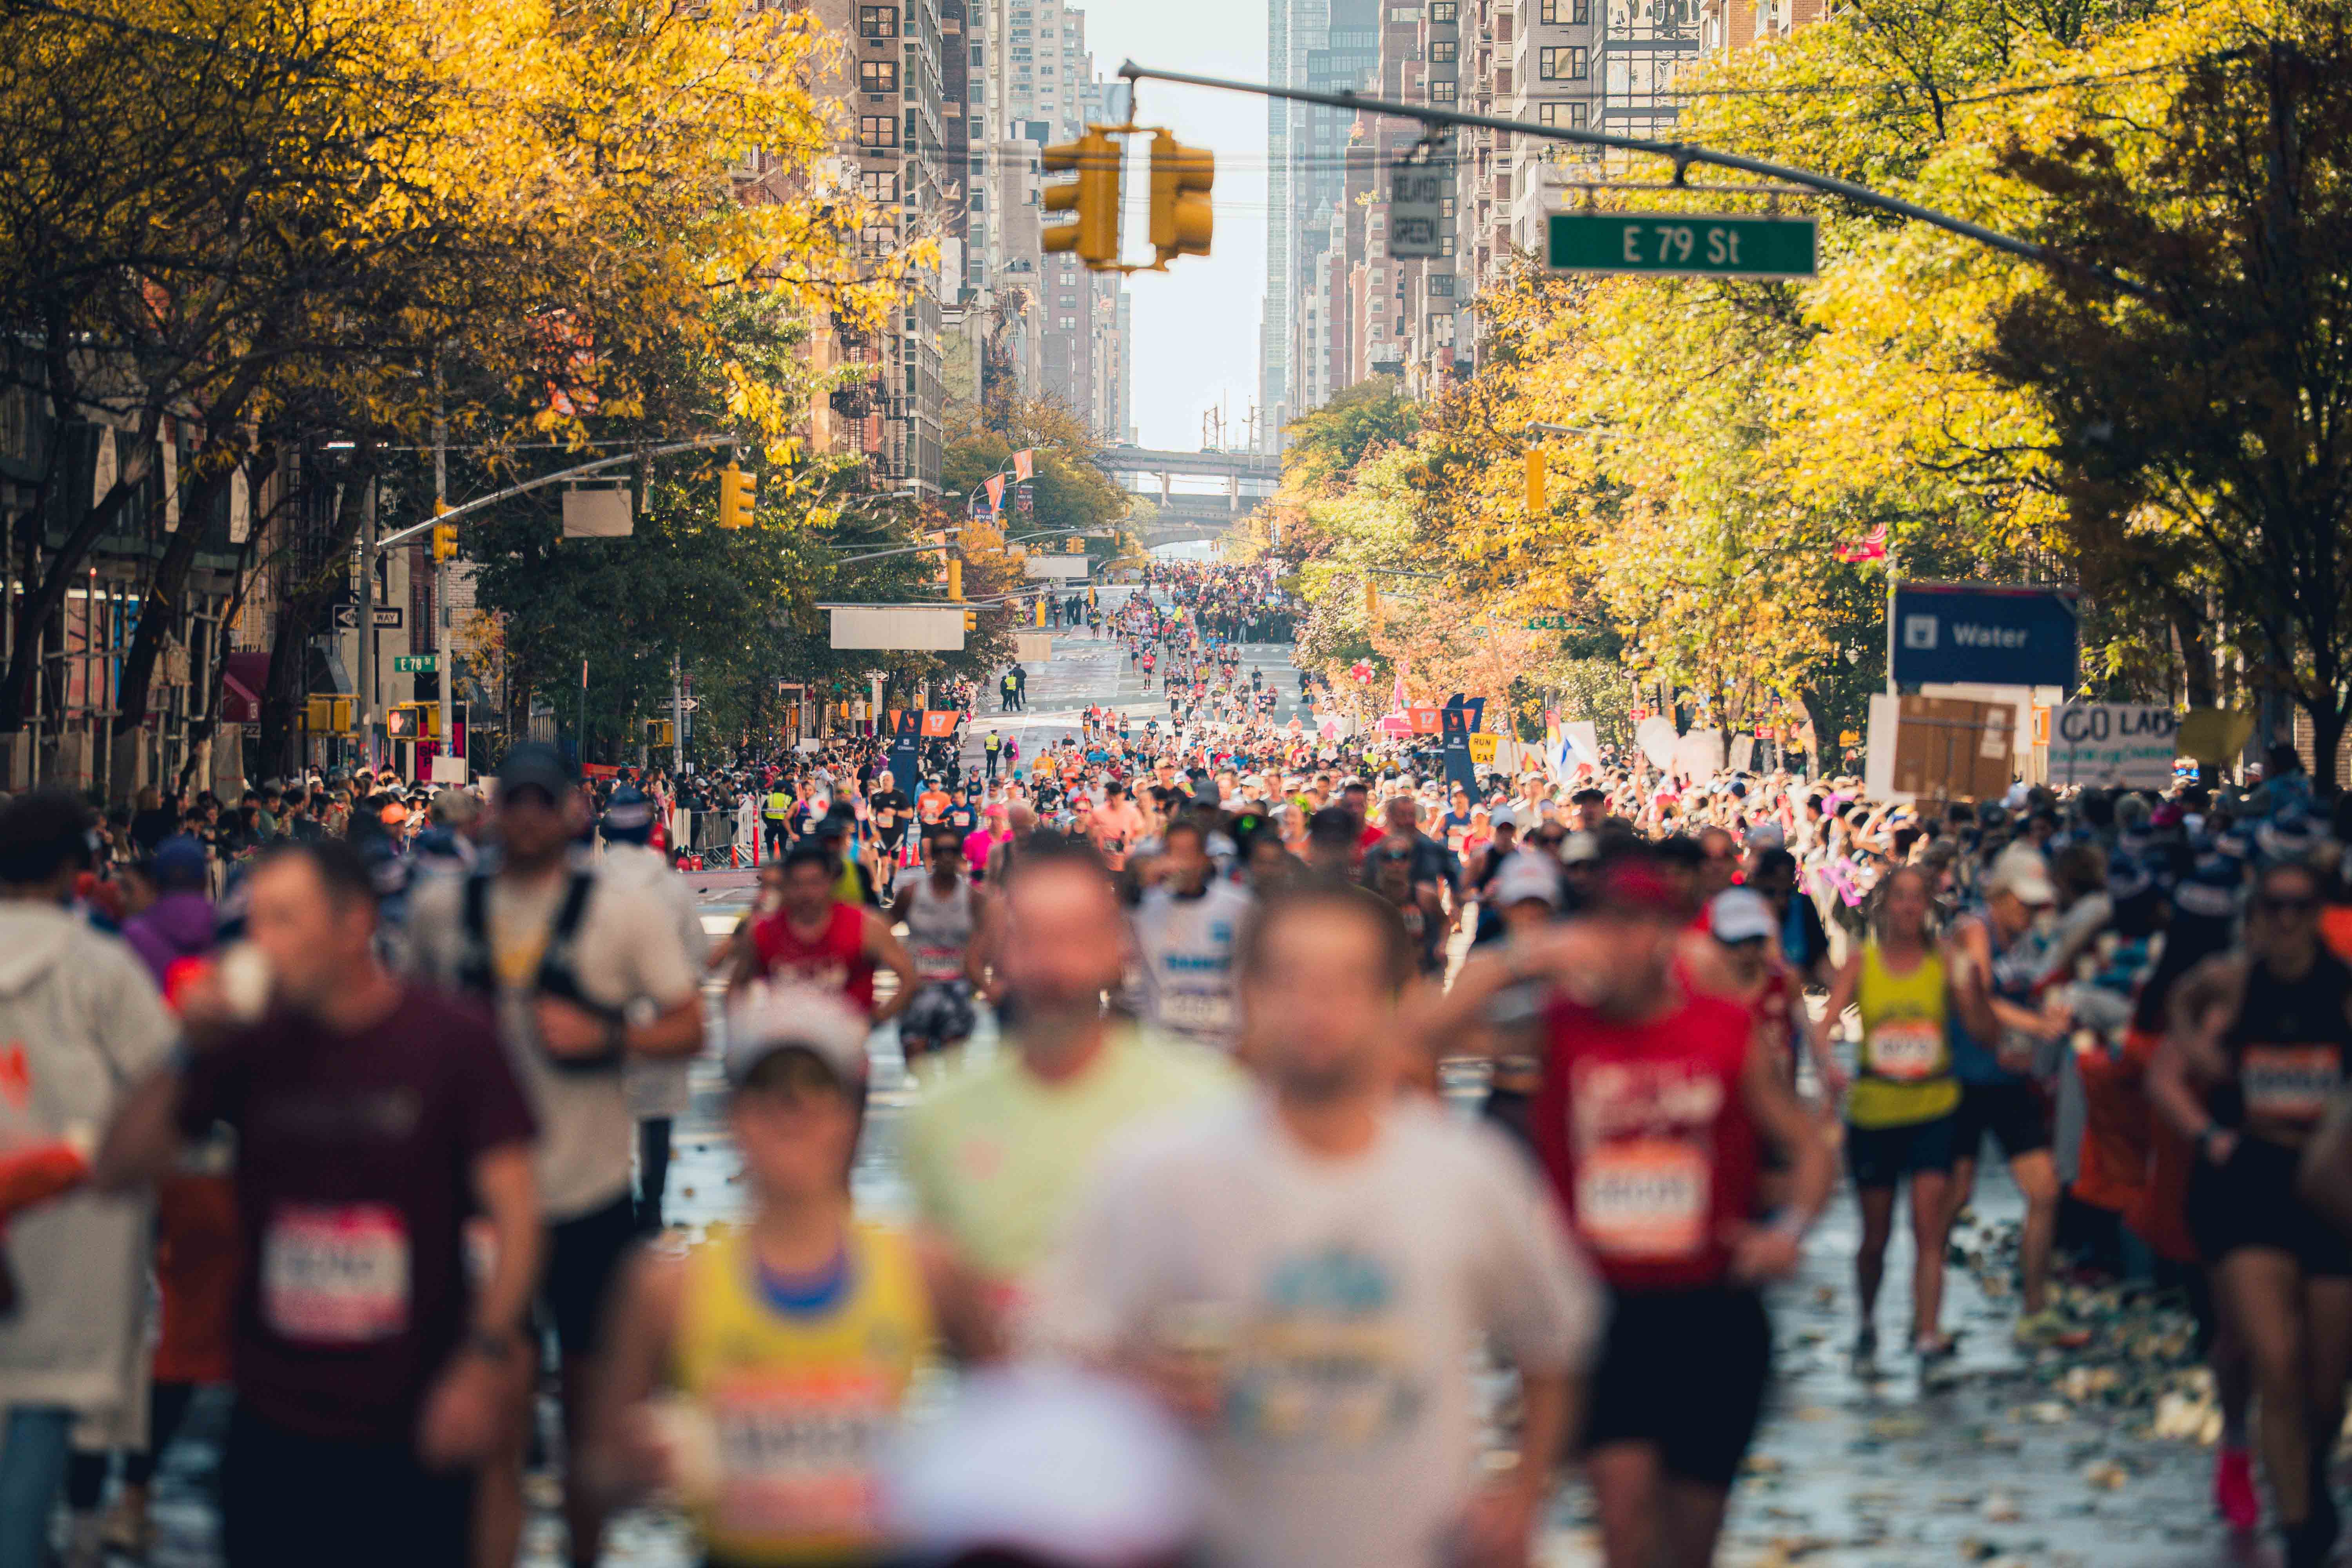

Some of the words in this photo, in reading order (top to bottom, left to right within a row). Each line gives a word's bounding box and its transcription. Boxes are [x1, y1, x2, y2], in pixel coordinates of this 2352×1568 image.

[1623, 225, 1642, 262] E
[1655, 226, 1694, 263] 79
[1706, 227, 1740, 264] St
[377, 614, 394, 622] WAY
[1953, 622, 2027, 648] Water
[401, 658, 407, 671] E
[929, 715, 946, 728] 17
[1419, 711, 1437, 724] 17
[1474, 738, 1491, 746] RUN
